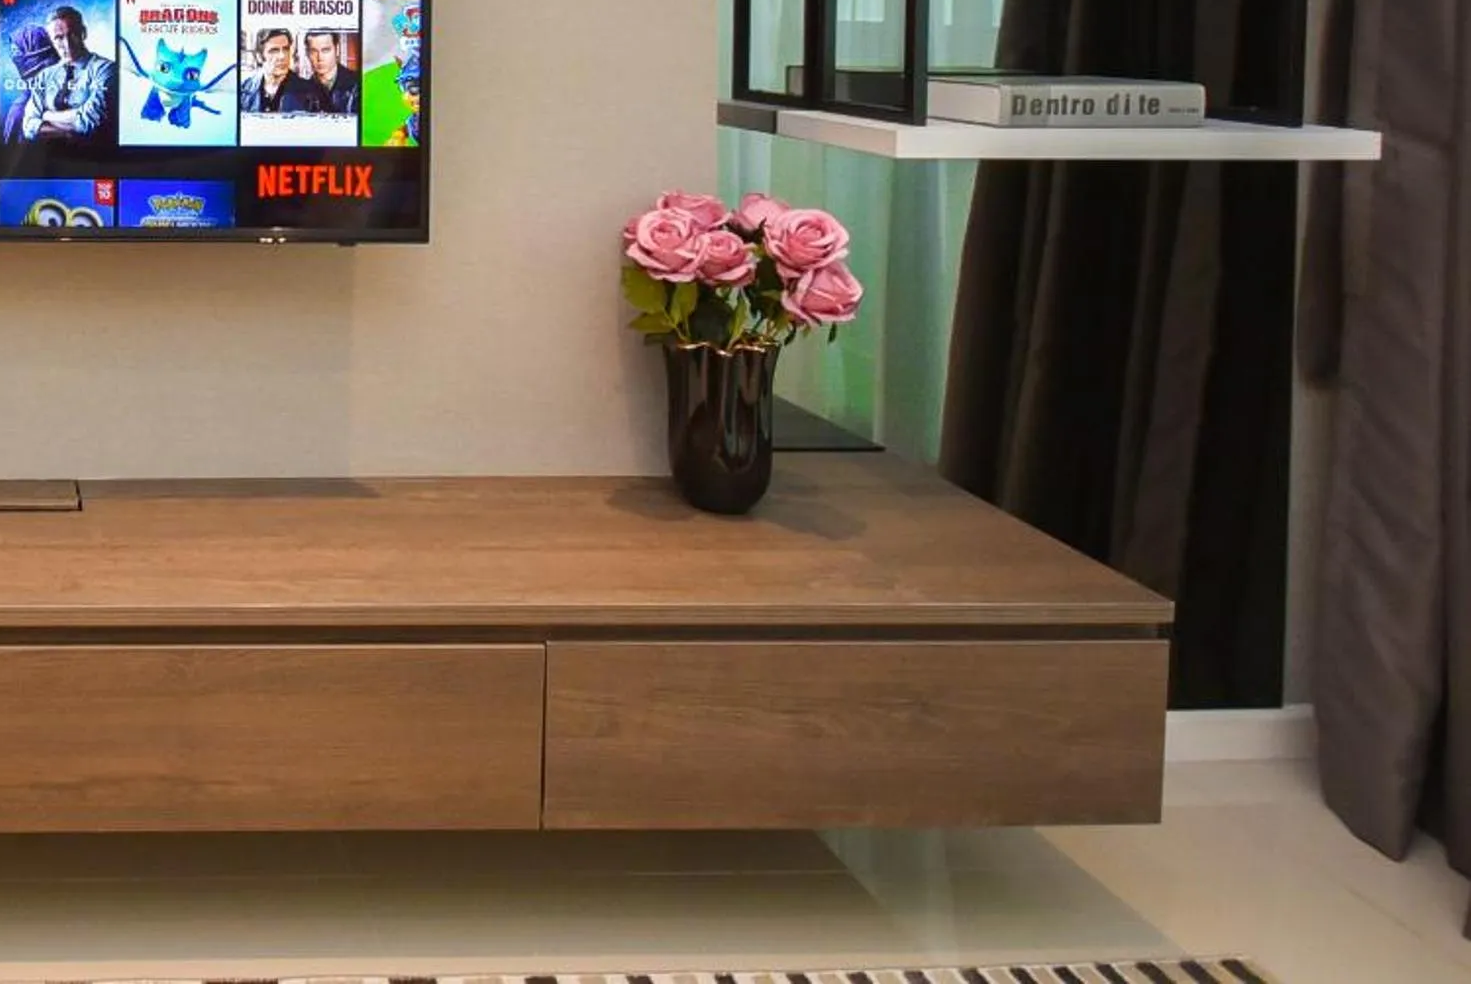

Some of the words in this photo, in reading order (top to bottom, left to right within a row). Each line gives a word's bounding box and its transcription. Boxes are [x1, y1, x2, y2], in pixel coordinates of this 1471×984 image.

[247, 0, 294, 15] DONNIE
[299, 0, 354, 15] BRASCO
[1011, 94, 1095, 116] Dentro
[1106, 93, 1130, 116] di
[1139, 94, 1160, 115] te
[257, 165, 373, 198] NETFLIX
